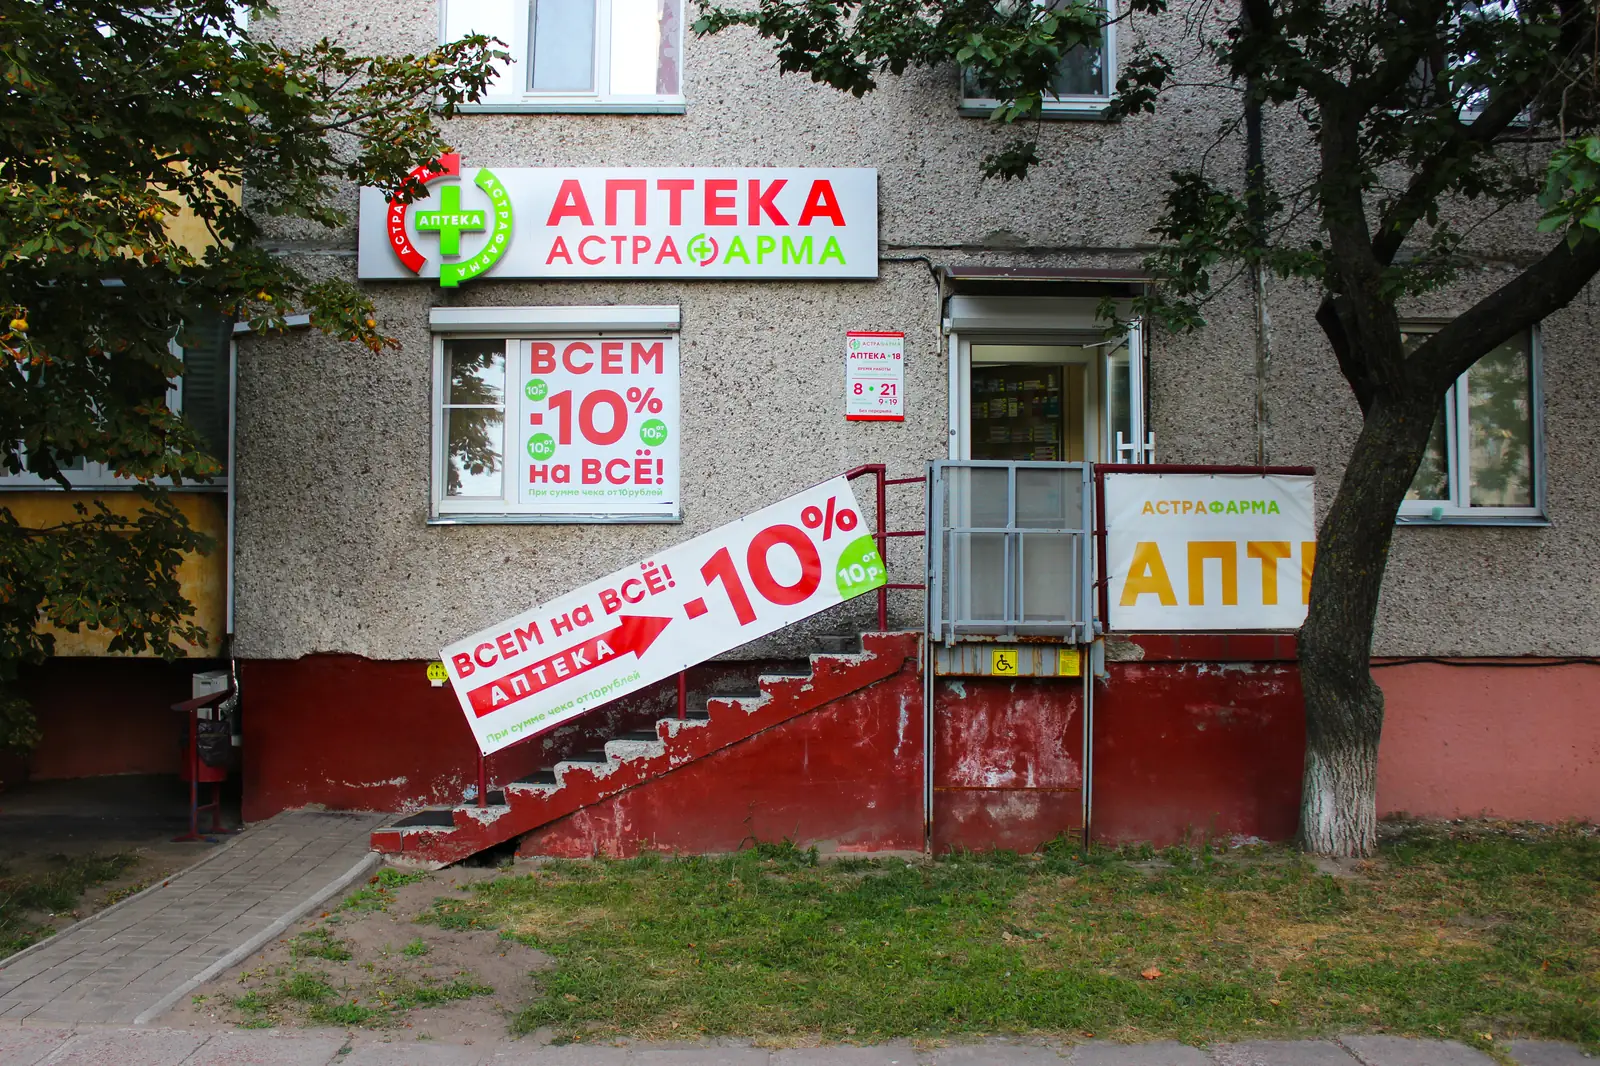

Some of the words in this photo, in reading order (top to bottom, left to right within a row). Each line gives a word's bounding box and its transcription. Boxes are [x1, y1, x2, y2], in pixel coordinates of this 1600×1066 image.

[419, 214, 481, 226] АПТЕКА
[546, 179, 847, 226] АПТЕКА
[457, 179, 508, 277] АСТРАФАРМА
[545, 233, 847, 266] АСТРАФАРМА
[530, 342, 664, 375] ВСЕМ
[850, 352, 886, 360] АПТЕКА
[891, 352, 901, 360] 18
[853, 383, 863, 395] 8
[880, 383, 897, 396] 21
[530, 386, 663, 446] -10%
[529, 464, 571, 484] на
[581, 449, 664, 485] ВСЁ!
[528, 488, 547, 498] При
[549, 489, 580, 498] сумме
[581, 489, 605, 497] чека
[1141, 500, 1281, 515] АСТРАФАРМА
[683, 496, 858, 627] -10%
[451, 621, 544, 680] ВСЕМ
[550, 604, 595, 637] на
[598, 561, 676, 616] ВСЁ!
[490, 638, 616, 707] АПТЕКА
[486, 729, 509, 744] При
[511, 712, 546, 733] сумме
[548, 700, 575, 716] чека
